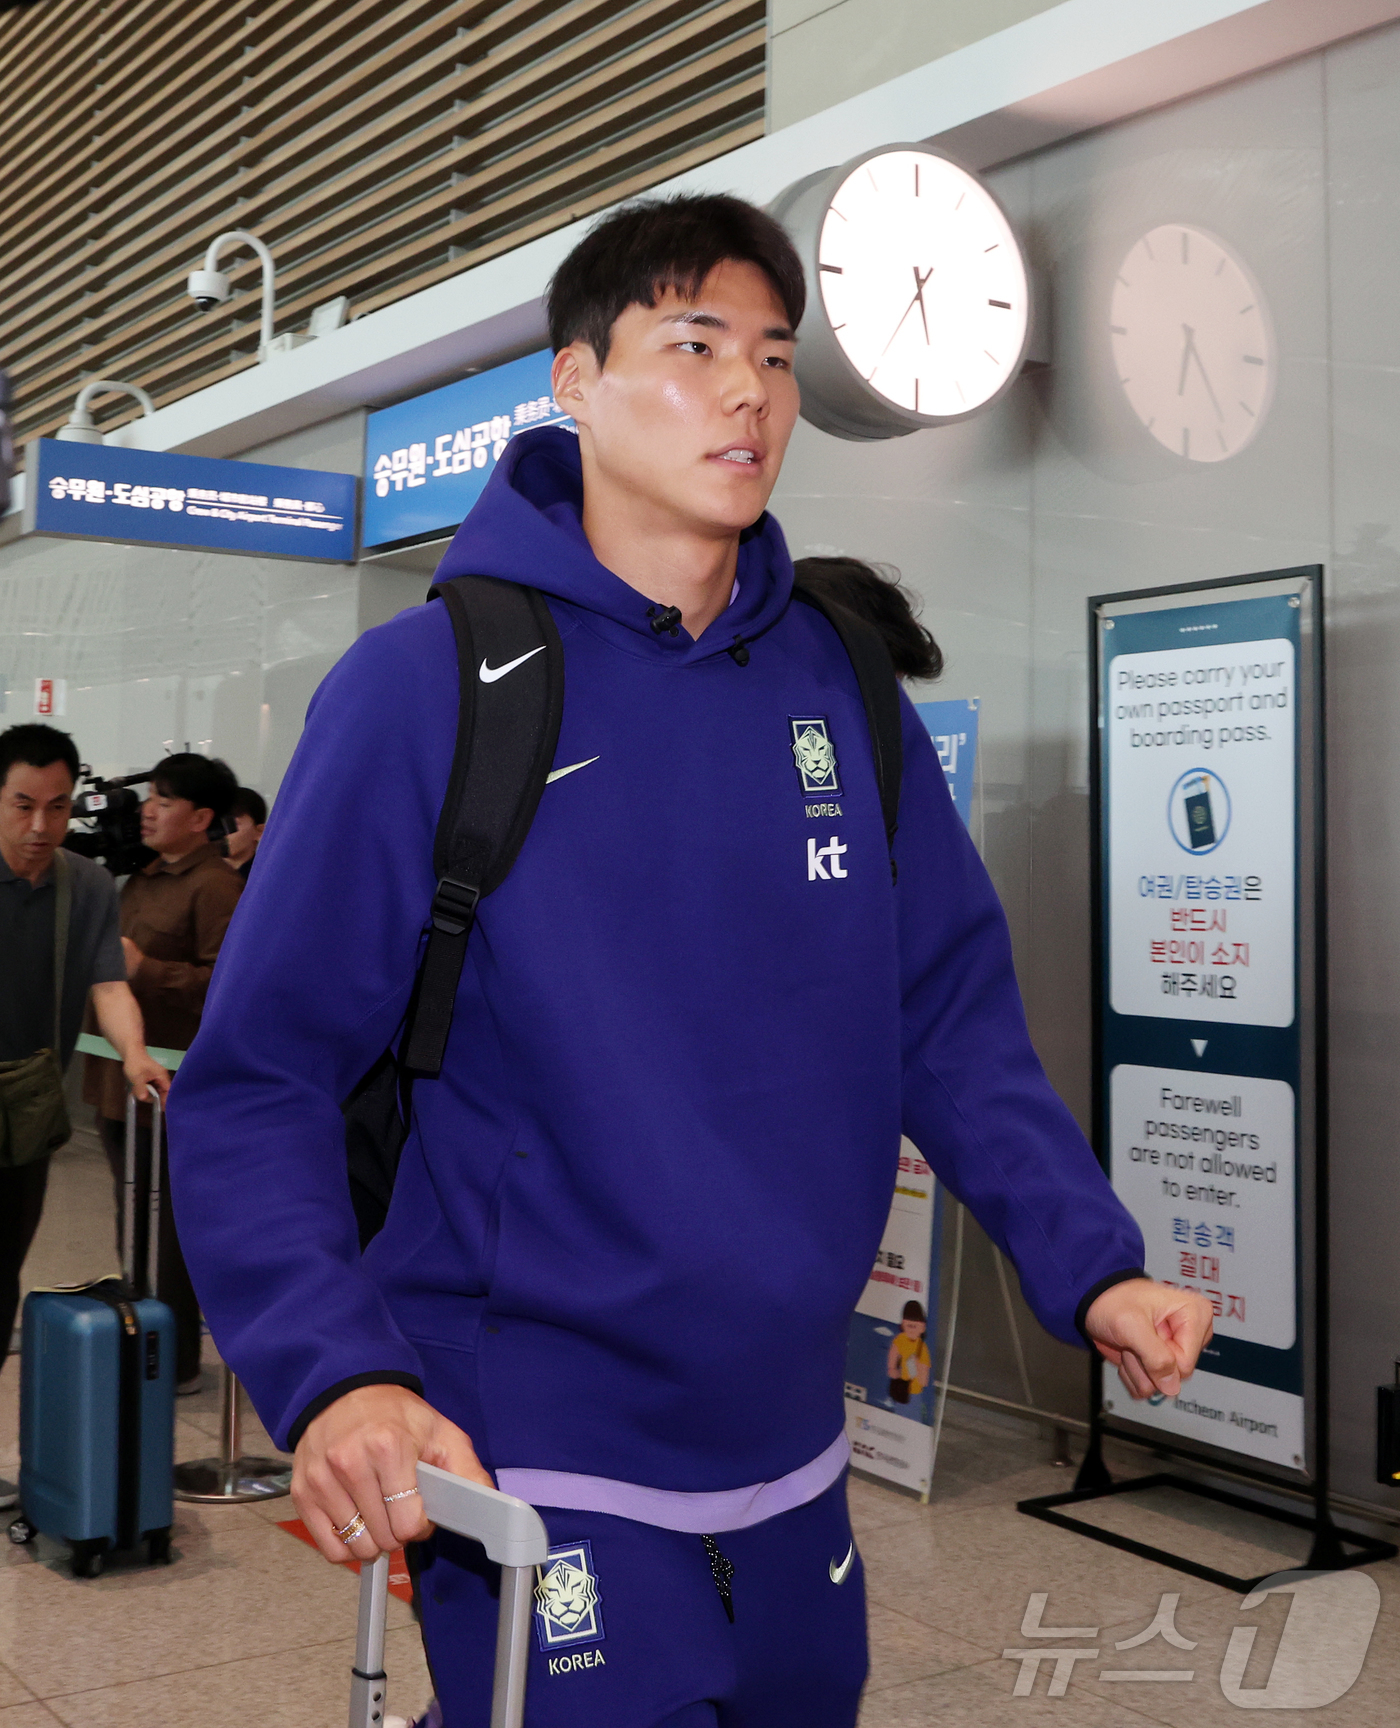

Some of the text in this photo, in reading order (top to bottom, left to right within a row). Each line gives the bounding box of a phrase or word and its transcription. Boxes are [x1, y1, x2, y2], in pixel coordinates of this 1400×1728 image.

[373, 415, 511, 498] 승무원·도심공항
[48, 476, 186, 512] 승무원·도심공항
[1117, 661, 1286, 690] Please carry your
[1115, 687, 1288, 722] own passport and
[1131, 724, 1272, 749] boarding pass.
[805, 803, 843, 818] KOREA
[807, 836, 848, 881] kt
[1138, 875, 1262, 901] 여권/탑승권은
[1170, 908, 1227, 933] 반드시
[1150, 939, 1250, 967] 본인이 소지
[1161, 972, 1237, 999] 해주세요
[1160, 1087, 1242, 1117] Farewell
[1145, 1120, 1260, 1151] passengers
[1129, 1146, 1277, 1184] are not allowed
[1162, 1177, 1240, 1208] to enter.
[1172, 1217, 1235, 1253] 환송객
[1179, 1251, 1220, 1283] 절대
[1163, 1280, 1246, 1322] 금지
[1174, 1396, 1279, 1438] Incheon Airport
[548, 1649, 606, 1675] KOREA
